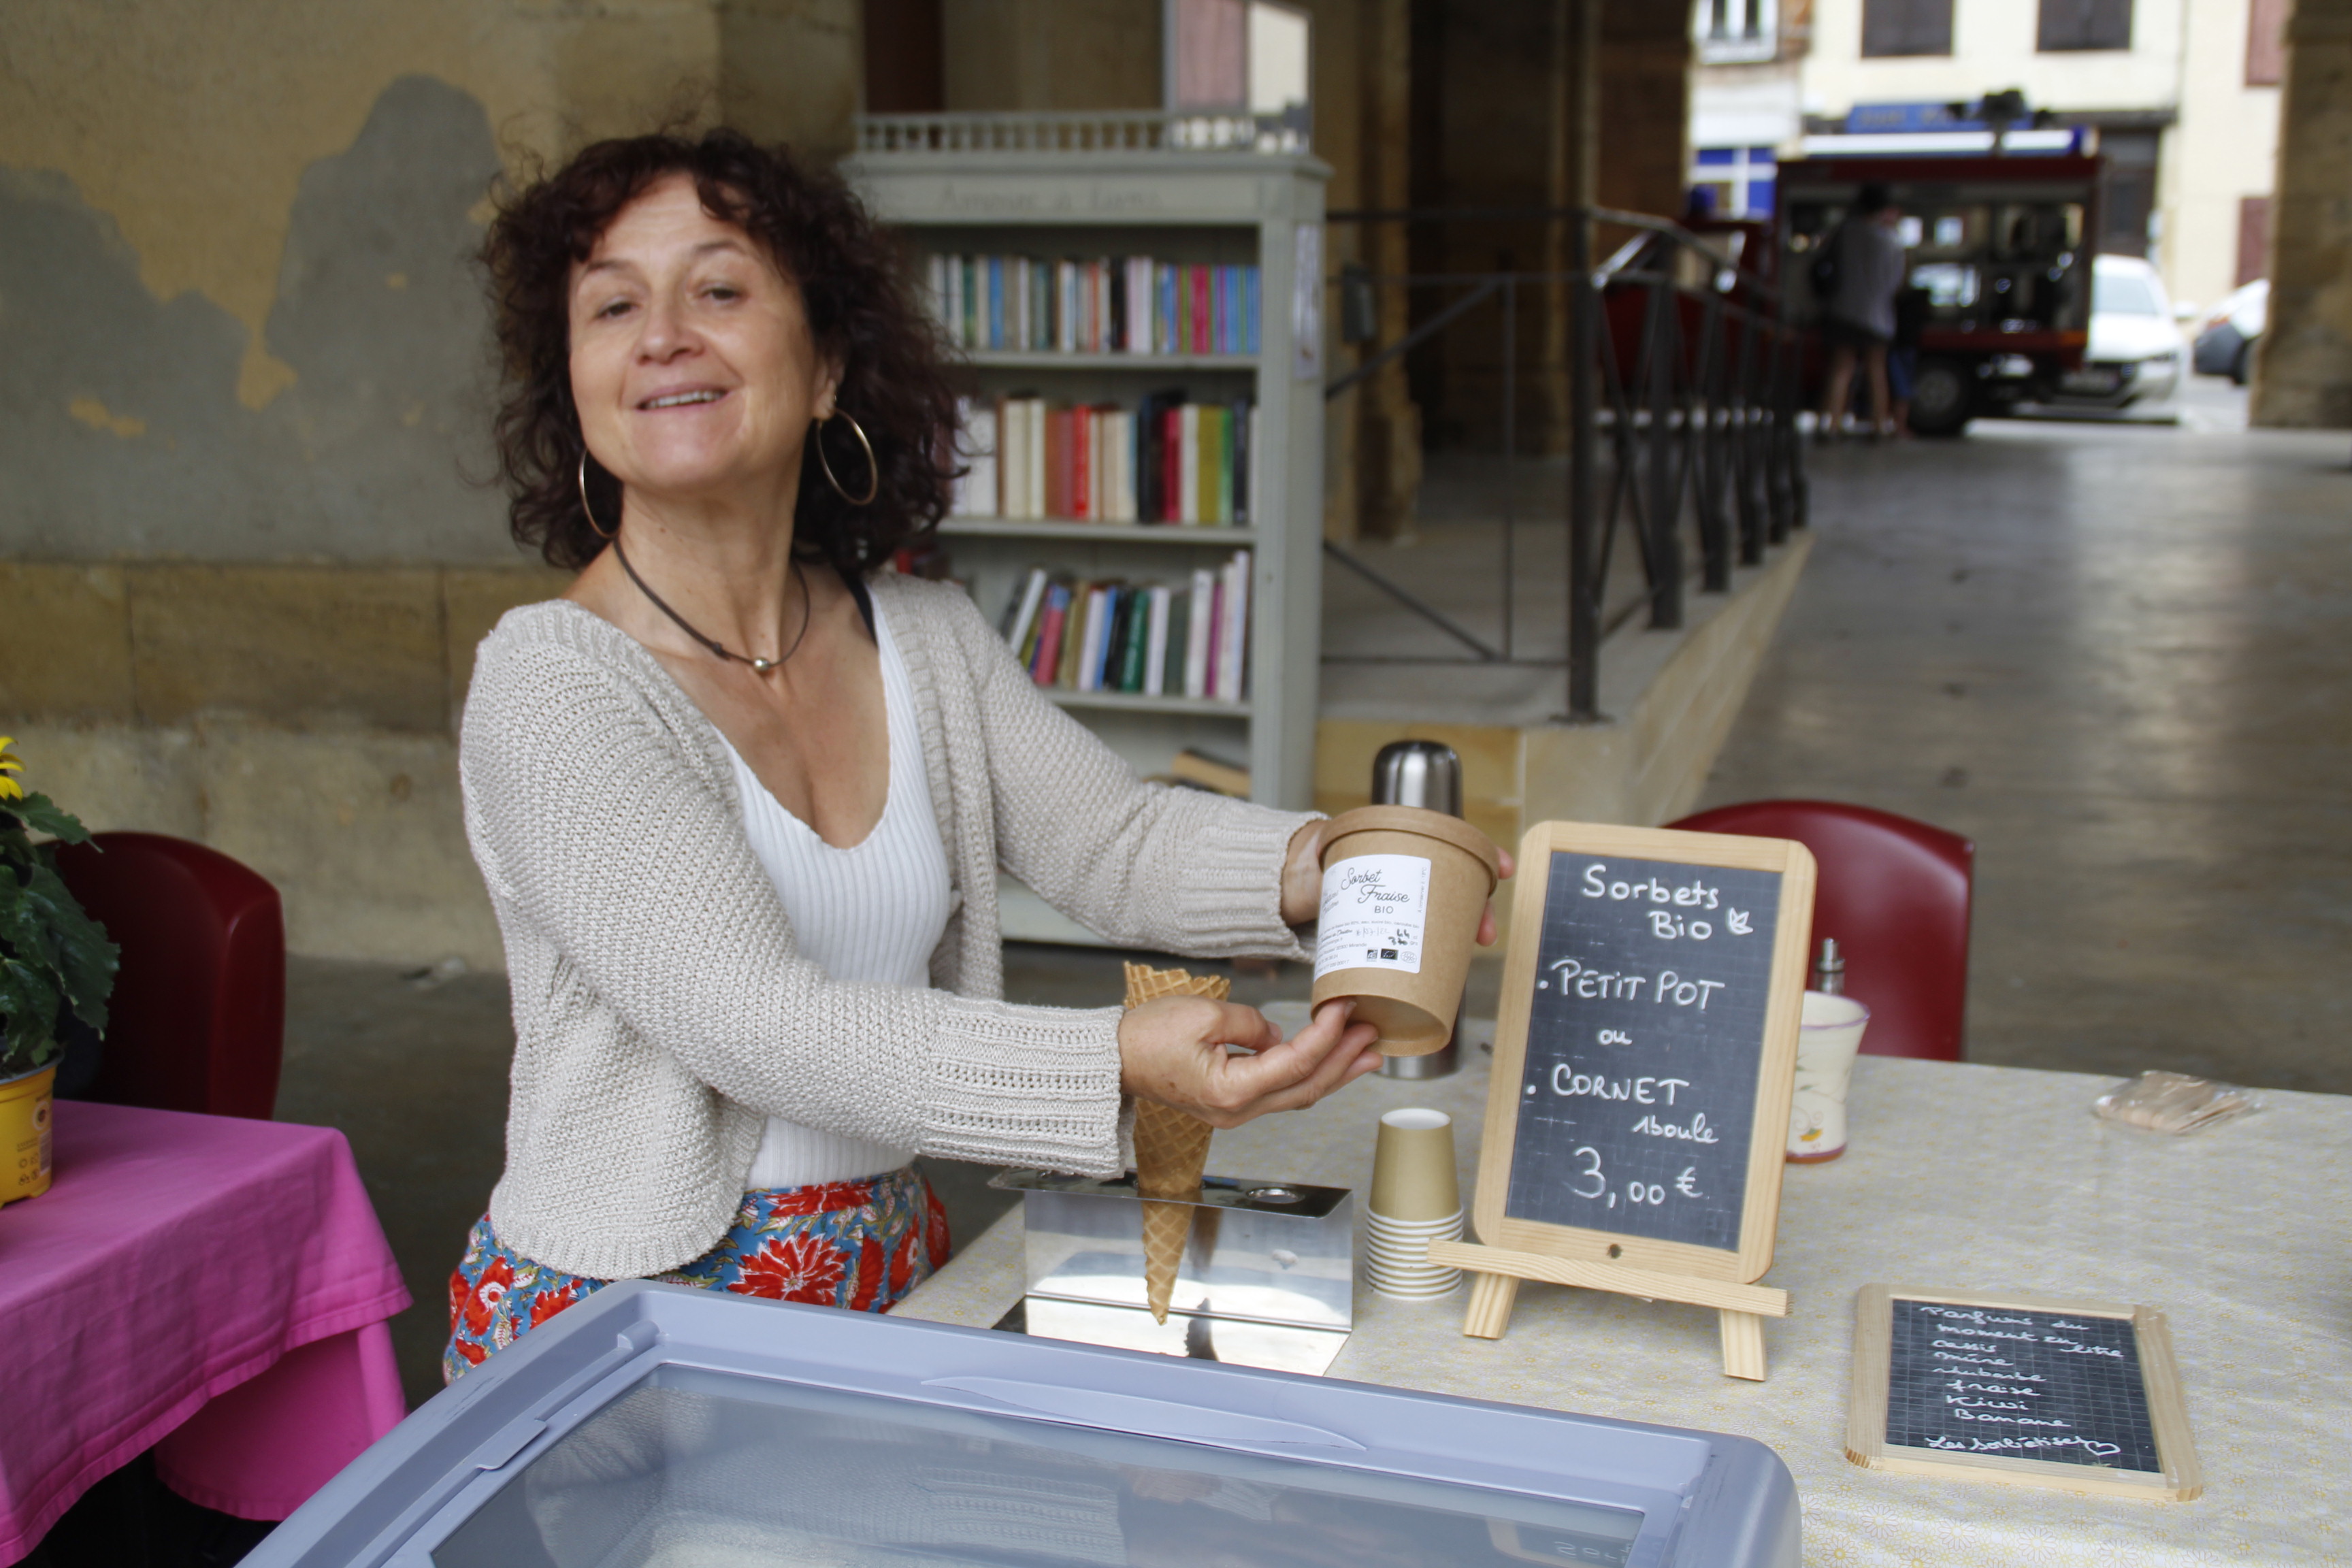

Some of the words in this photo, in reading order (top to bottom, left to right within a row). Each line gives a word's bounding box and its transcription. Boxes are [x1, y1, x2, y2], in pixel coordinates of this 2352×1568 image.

[1341, 867, 1382, 891] Sorbet
[1582, 864, 1719, 909] Sorbets
[1358, 885, 1410, 904] Fraise
[1374, 906, 1394, 914] BIO
[1648, 911, 1712, 940] Bio
[1654, 970, 1725, 1009] POT
[1598, 1028, 1633, 1045] ou
[1552, 1063, 1690, 1106] CORNET
[1954, 1408, 2072, 1427] Banane
[1925, 1435, 1965, 1450] Les
